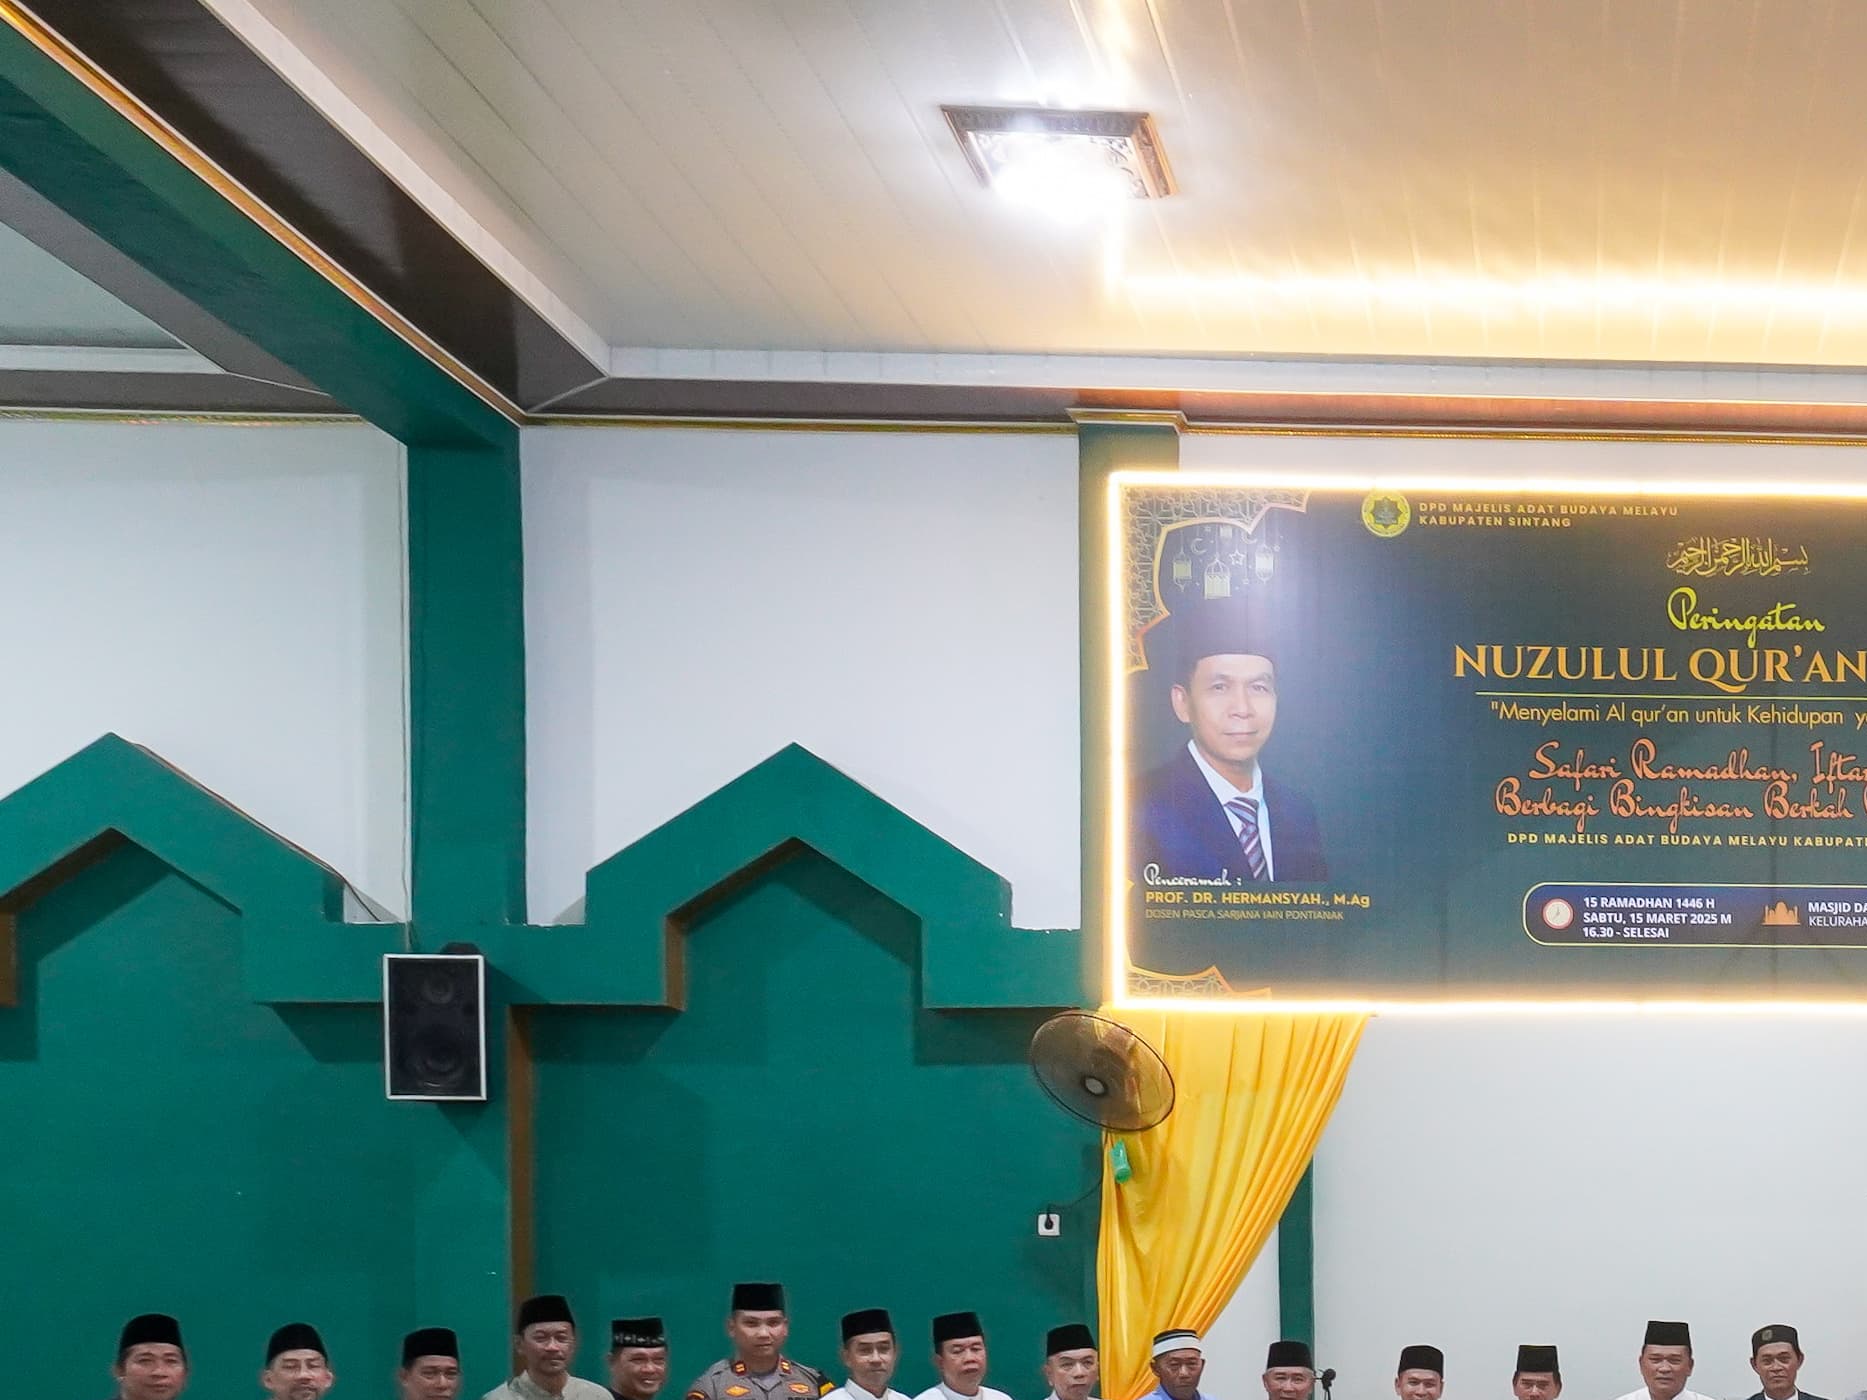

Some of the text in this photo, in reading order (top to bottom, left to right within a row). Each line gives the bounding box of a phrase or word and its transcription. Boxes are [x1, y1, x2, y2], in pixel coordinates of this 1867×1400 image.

[1419, 503, 1678, 516] DPD MAJELIS ADAT BUDAYA MELAYU
[1419, 516, 1571, 527] KABUPATEN SINTANG
[1666, 586, 1826, 649] Peringatan
[1454, 644, 1678, 681] NUZULUL
[1689, 645, 1867, 693] QUR'AN
[1491, 701, 1600, 727] "Menyelami
[1606, 702, 1625, 722] Al
[1696, 704, 1741, 723] untuk
[1747, 704, 1844, 730] Kehidupan
[1528, 740, 1623, 792] Safari
[1631, 737, 1798, 782] Ramadhan,
[1496, 776, 1600, 834] Berbagi
[1610, 778, 1754, 834] Bingkisan
[1763, 780, 1855, 820] Berkah
[1507, 833, 1538, 844] DPD
[1544, 833, 1608, 845] MAJELIS
[1614, 834, 1655, 845] ADAT
[1661, 835, 1722, 846] BUDAYA
[1728, 835, 1788, 846] MELAYU
[1144, 863, 1232, 886] Penceramah
[1145, 891, 1188, 904] PROF.
[1192, 892, 1217, 905] DR.
[1333, 894, 1371, 908] M.Ag
[1584, 897, 1715, 909] 15 RAMADHAN 1446 H
[1808, 901, 1851, 914] MASJID
[1145, 908, 1180, 919] DOSEN
[1182, 909, 1216, 920] PASCA
[1217, 909, 1261, 921] SARJANA
[1285, 910, 1344, 921] PONTIANAK
[1583, 912, 1732, 925] SABTU, 15 MARET 2025 M
[1583, 926, 1614, 938] 16.30
[1623, 927, 1670, 938] SELESAI
